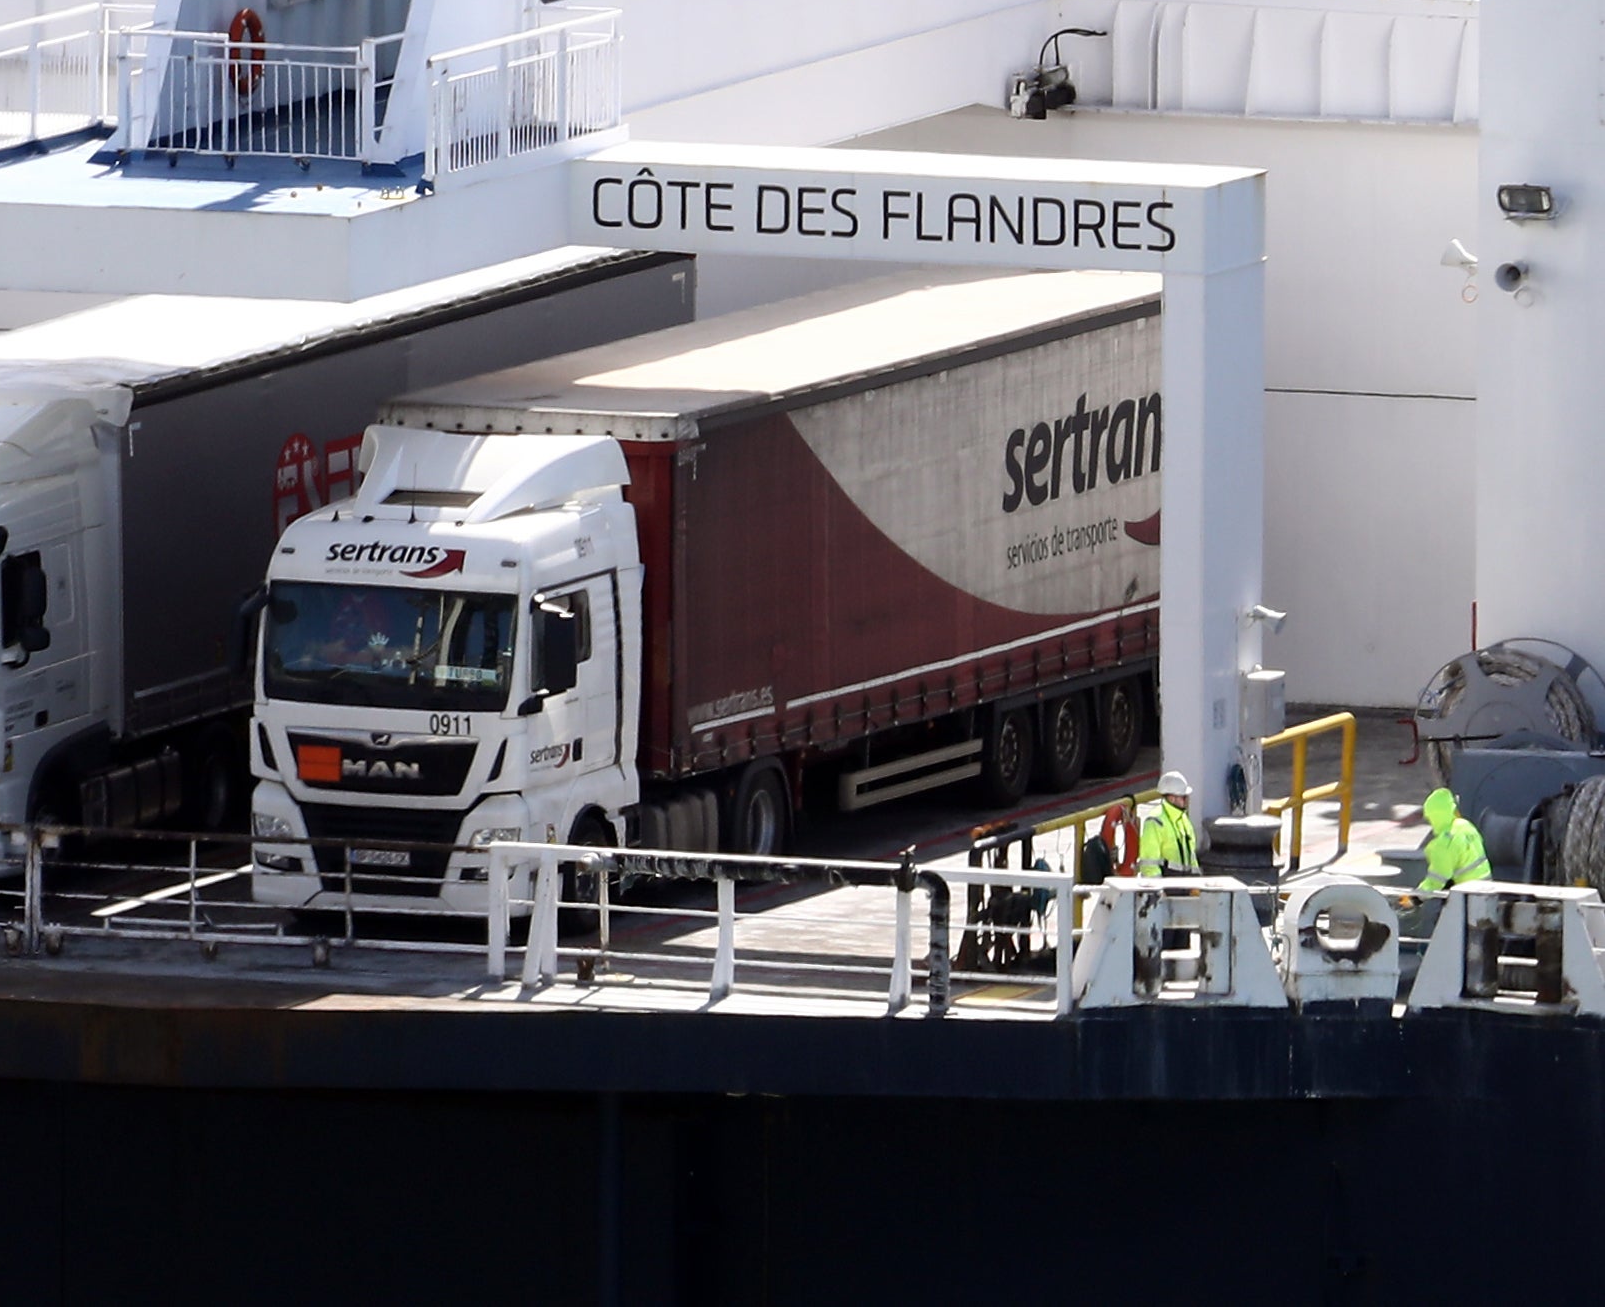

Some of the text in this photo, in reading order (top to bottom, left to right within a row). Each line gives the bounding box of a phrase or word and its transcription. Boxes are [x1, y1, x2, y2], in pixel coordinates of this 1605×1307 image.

[592, 166, 1176, 253] CÔTE DES FLANDRES
[1002, 392, 1162, 514] sertran
[325, 540, 440, 565] sertrans
[1007, 516, 1118, 570] servicios de transporte
[430, 713, 471, 735] 0911
[341, 759, 422, 779] MAN
